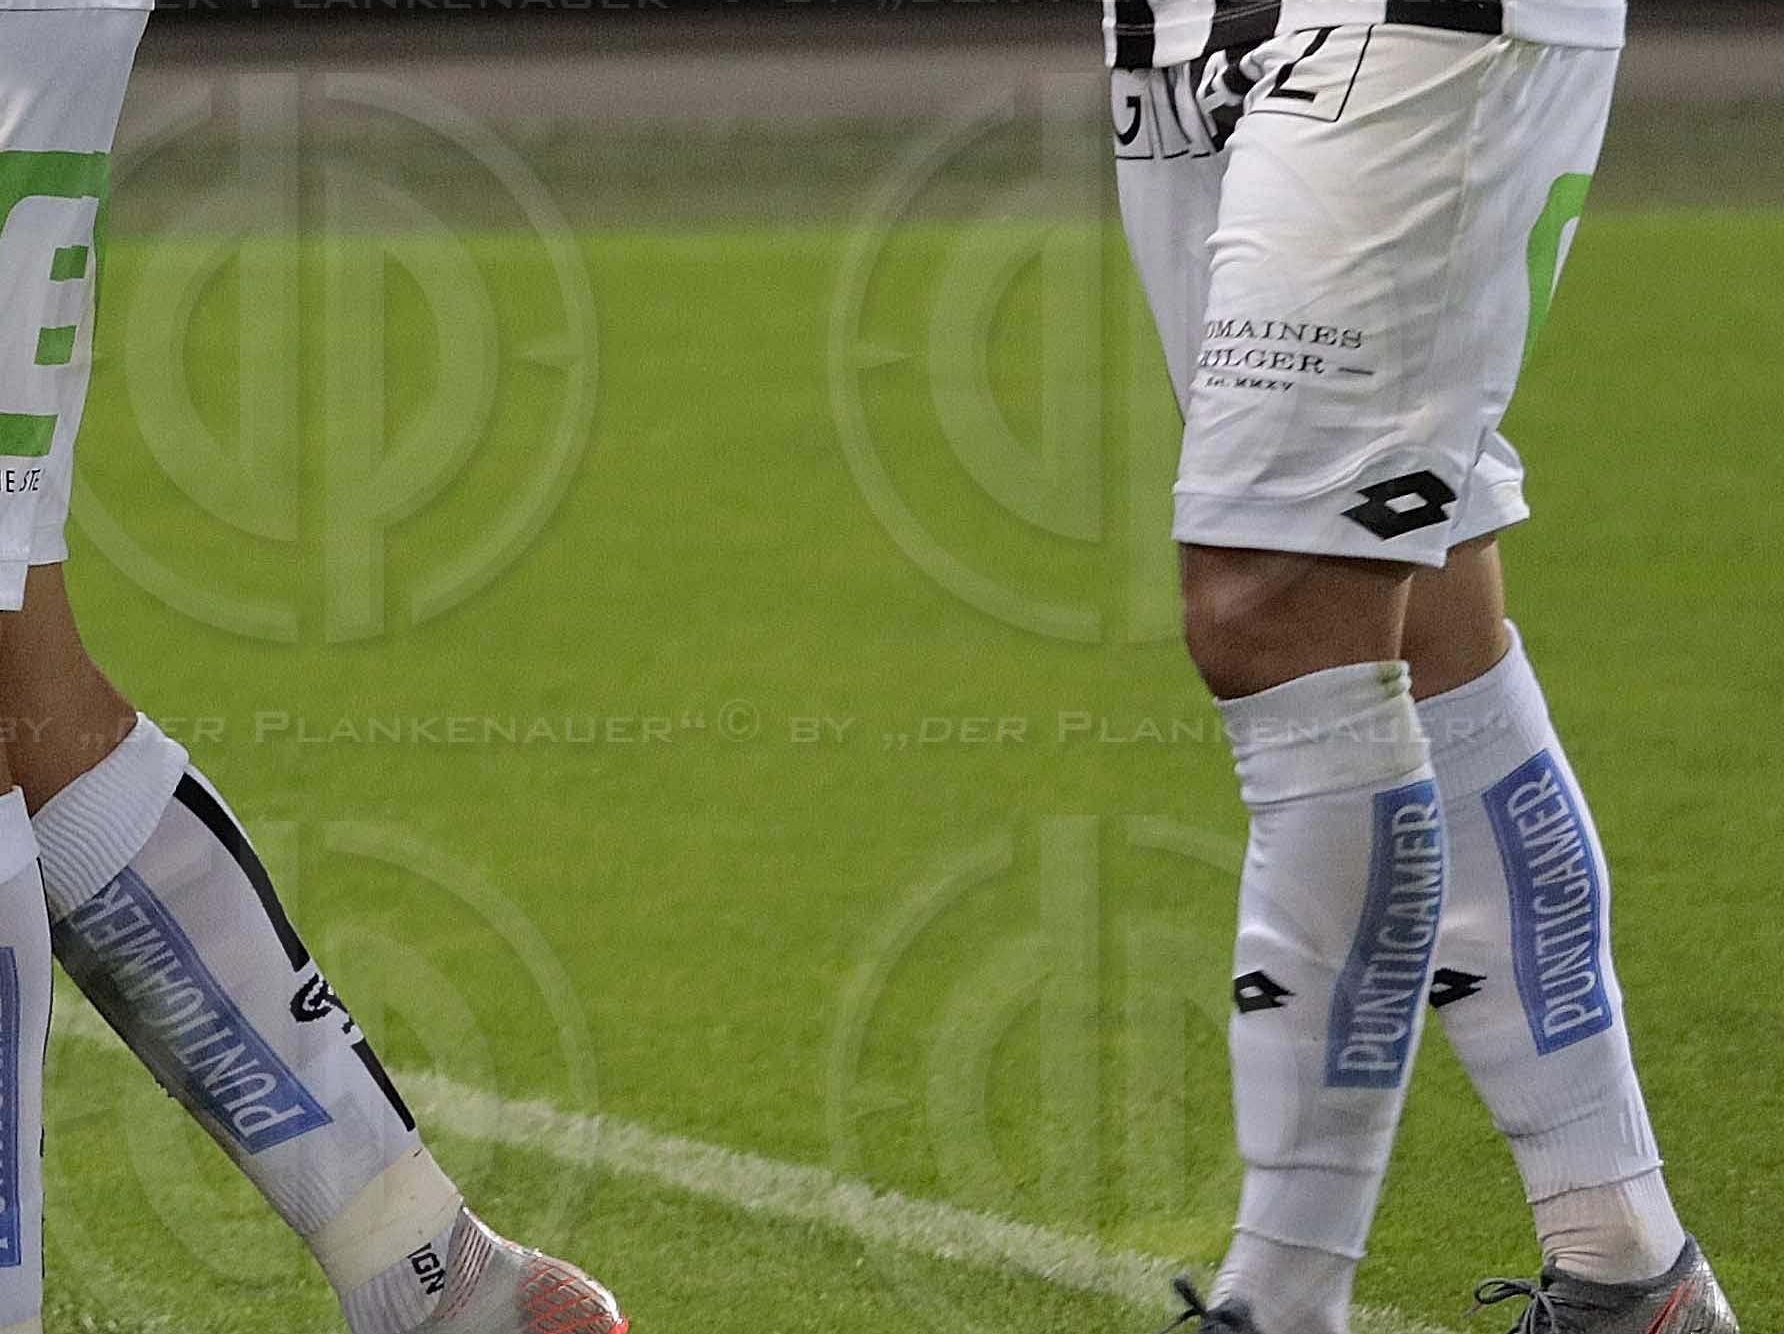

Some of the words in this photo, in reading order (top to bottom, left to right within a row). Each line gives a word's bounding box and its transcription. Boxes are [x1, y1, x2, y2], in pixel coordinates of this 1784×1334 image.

[82, 888, 300, 1145] PUNTIGAMER
[1337, 801, 1441, 1075] PUNTIGAMER
[1505, 767, 1604, 1043] PUNTIGAMER
